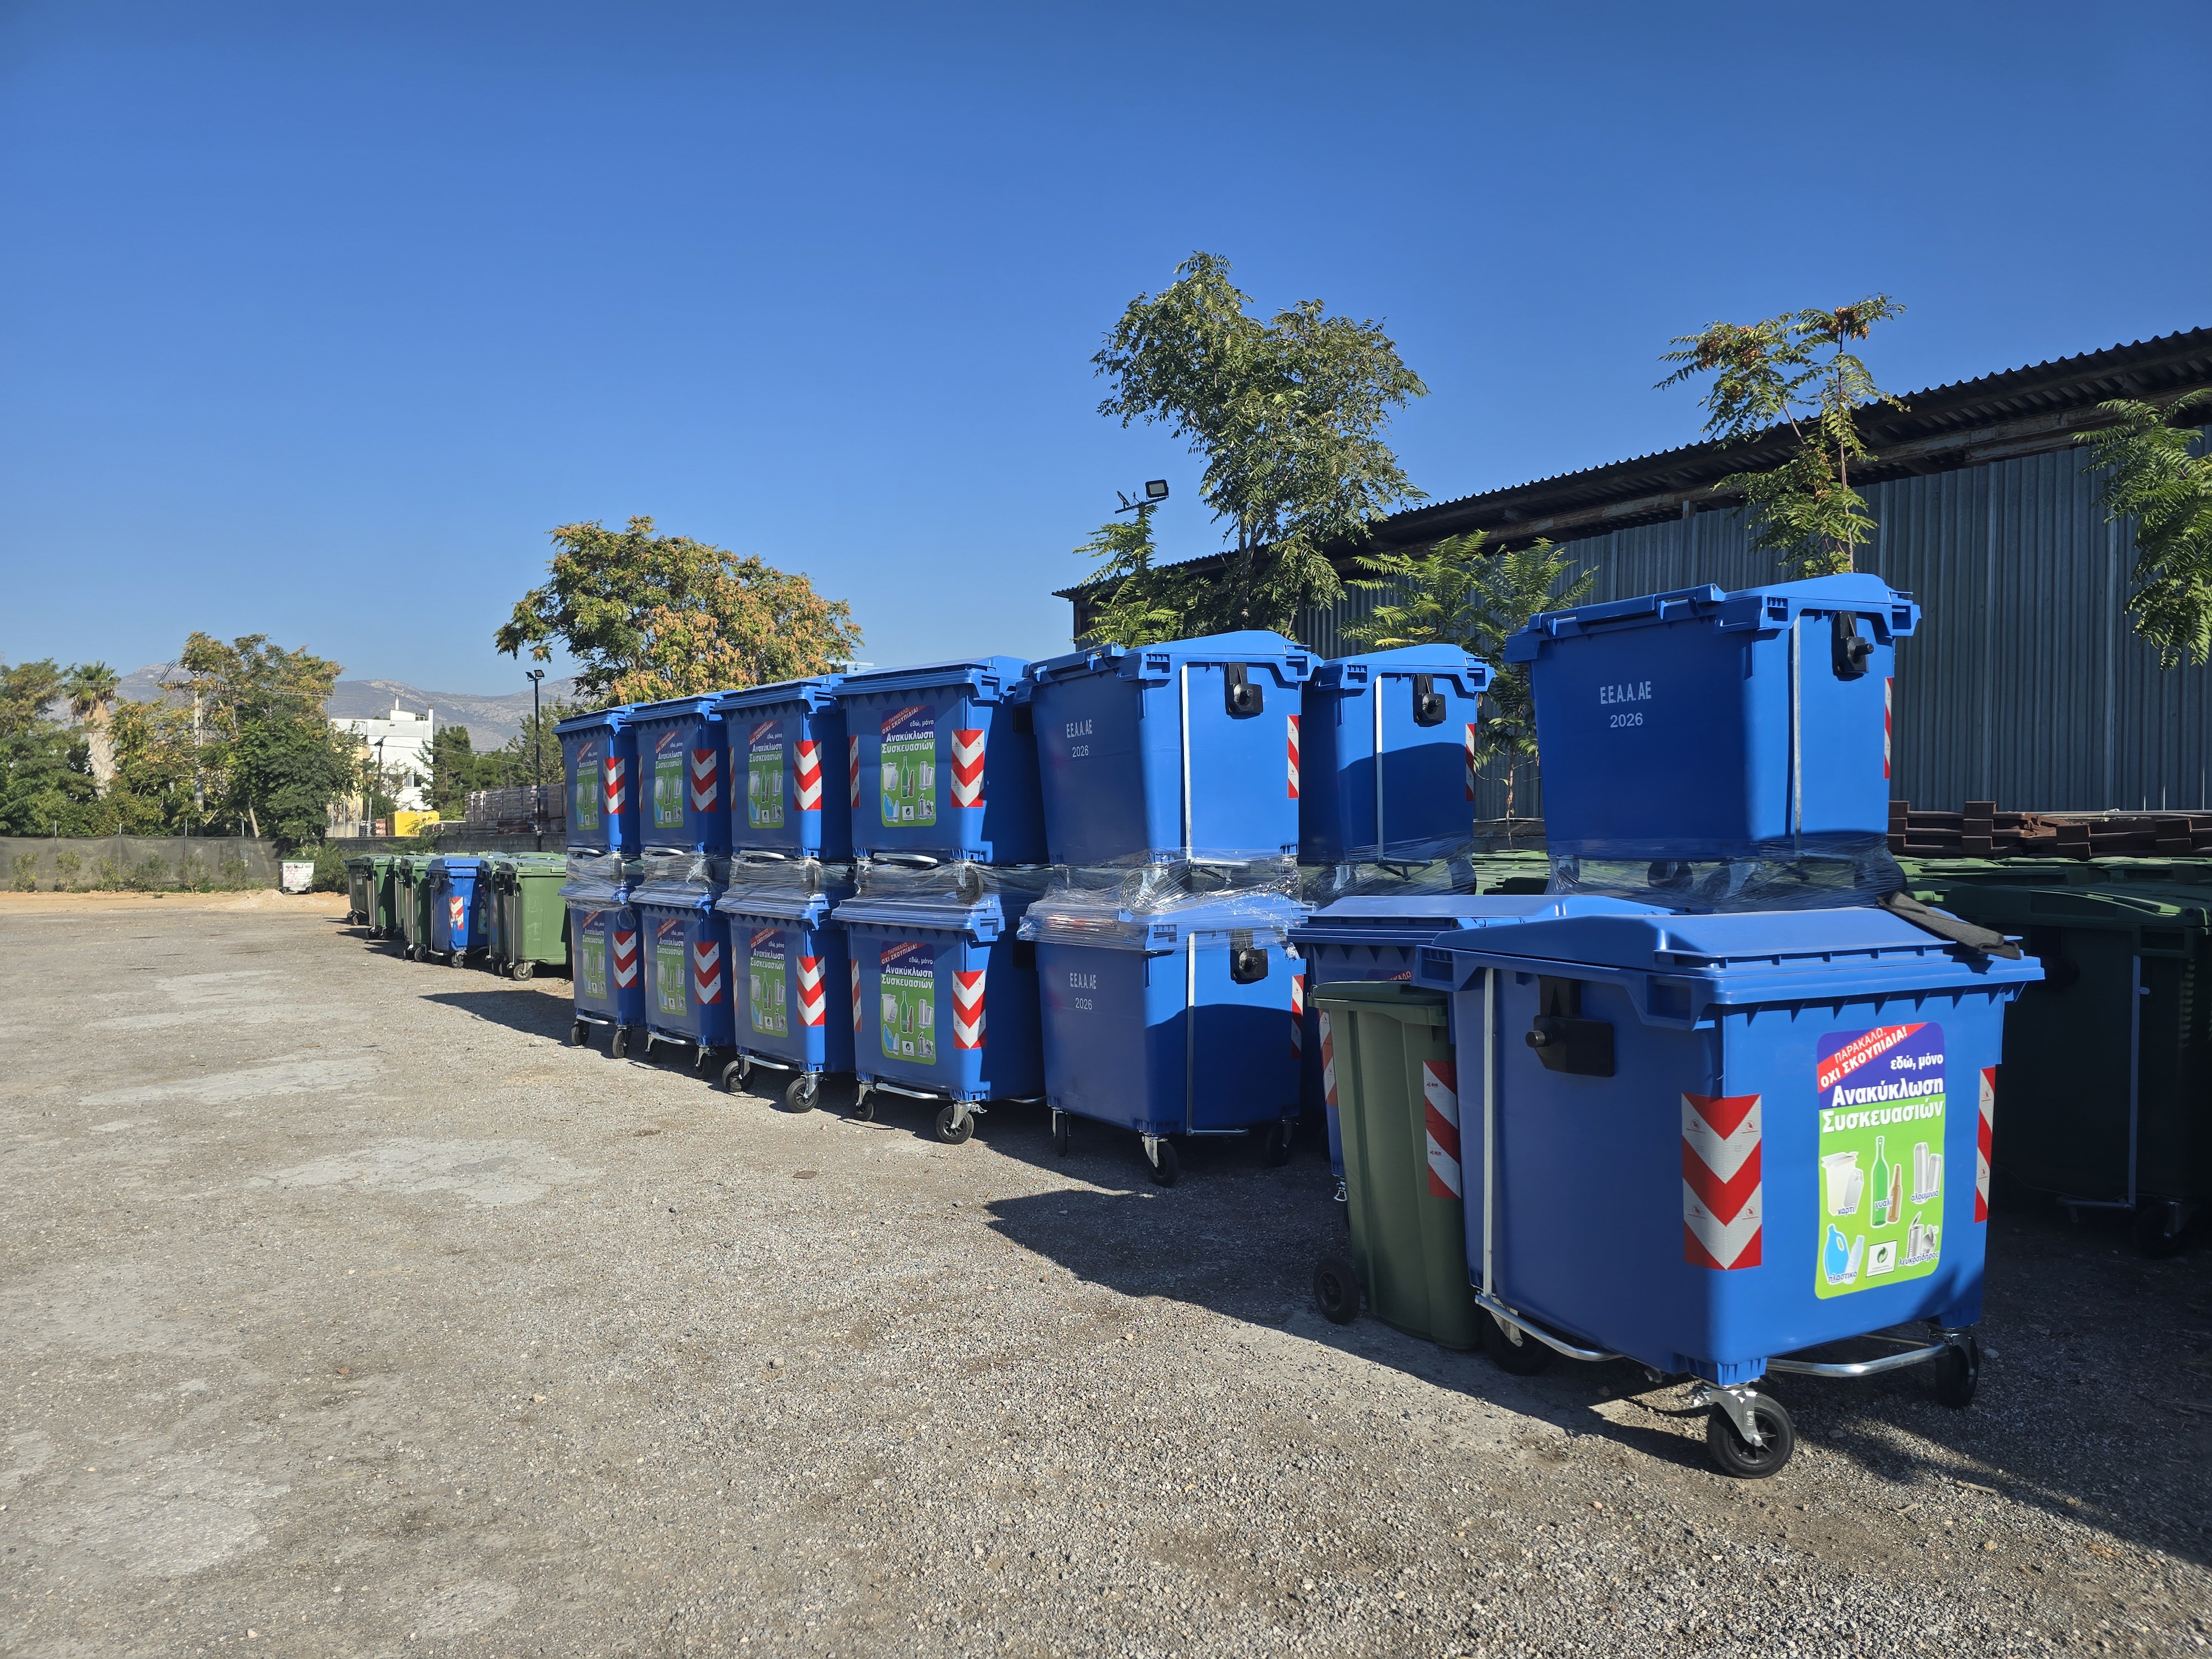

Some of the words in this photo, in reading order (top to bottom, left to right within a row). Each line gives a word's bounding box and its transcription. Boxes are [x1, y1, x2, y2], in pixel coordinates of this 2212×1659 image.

[1638, 681, 1652, 700] ΑΕ
[922, 719, 933, 727] μόνο
[1610, 712, 1643, 728] 2026
[886, 731, 933, 742] Ανακύκλωση
[881, 740, 933, 754] Συσκευασιών
[1072, 745, 1089, 758] 2026
[885, 964, 932, 978] Ανακύκλωση
[881, 974, 933, 989] Συσκευασιών
[1075, 997, 1092, 1010] 2026
[1834, 1027, 1887, 1063] ΠΑΡΑΚΑΛΩ,
[1820, 1068, 1841, 1087] ΟΧΙ
[1842, 1026, 1908, 1073] ΣΚΟΥΠΙΔΙΑ!
[1890, 1055, 1916, 1071] εδώ,
[1918, 1052, 1944, 1070] μόνο
[1832, 1078, 1944, 1107] Ανακύκλωση
[1822, 1098, 1944, 1133] Συσκευασιών
[1911, 1190, 1939, 1201] αλουμίνιο
[1838, 1203, 1855, 1215] χαρτί
[1875, 1197, 1892, 1210] γυαλί
[1898, 1251, 1939, 1266] λευκοσίδηρος
[1828, 1269, 1858, 1282] πλαστικό
